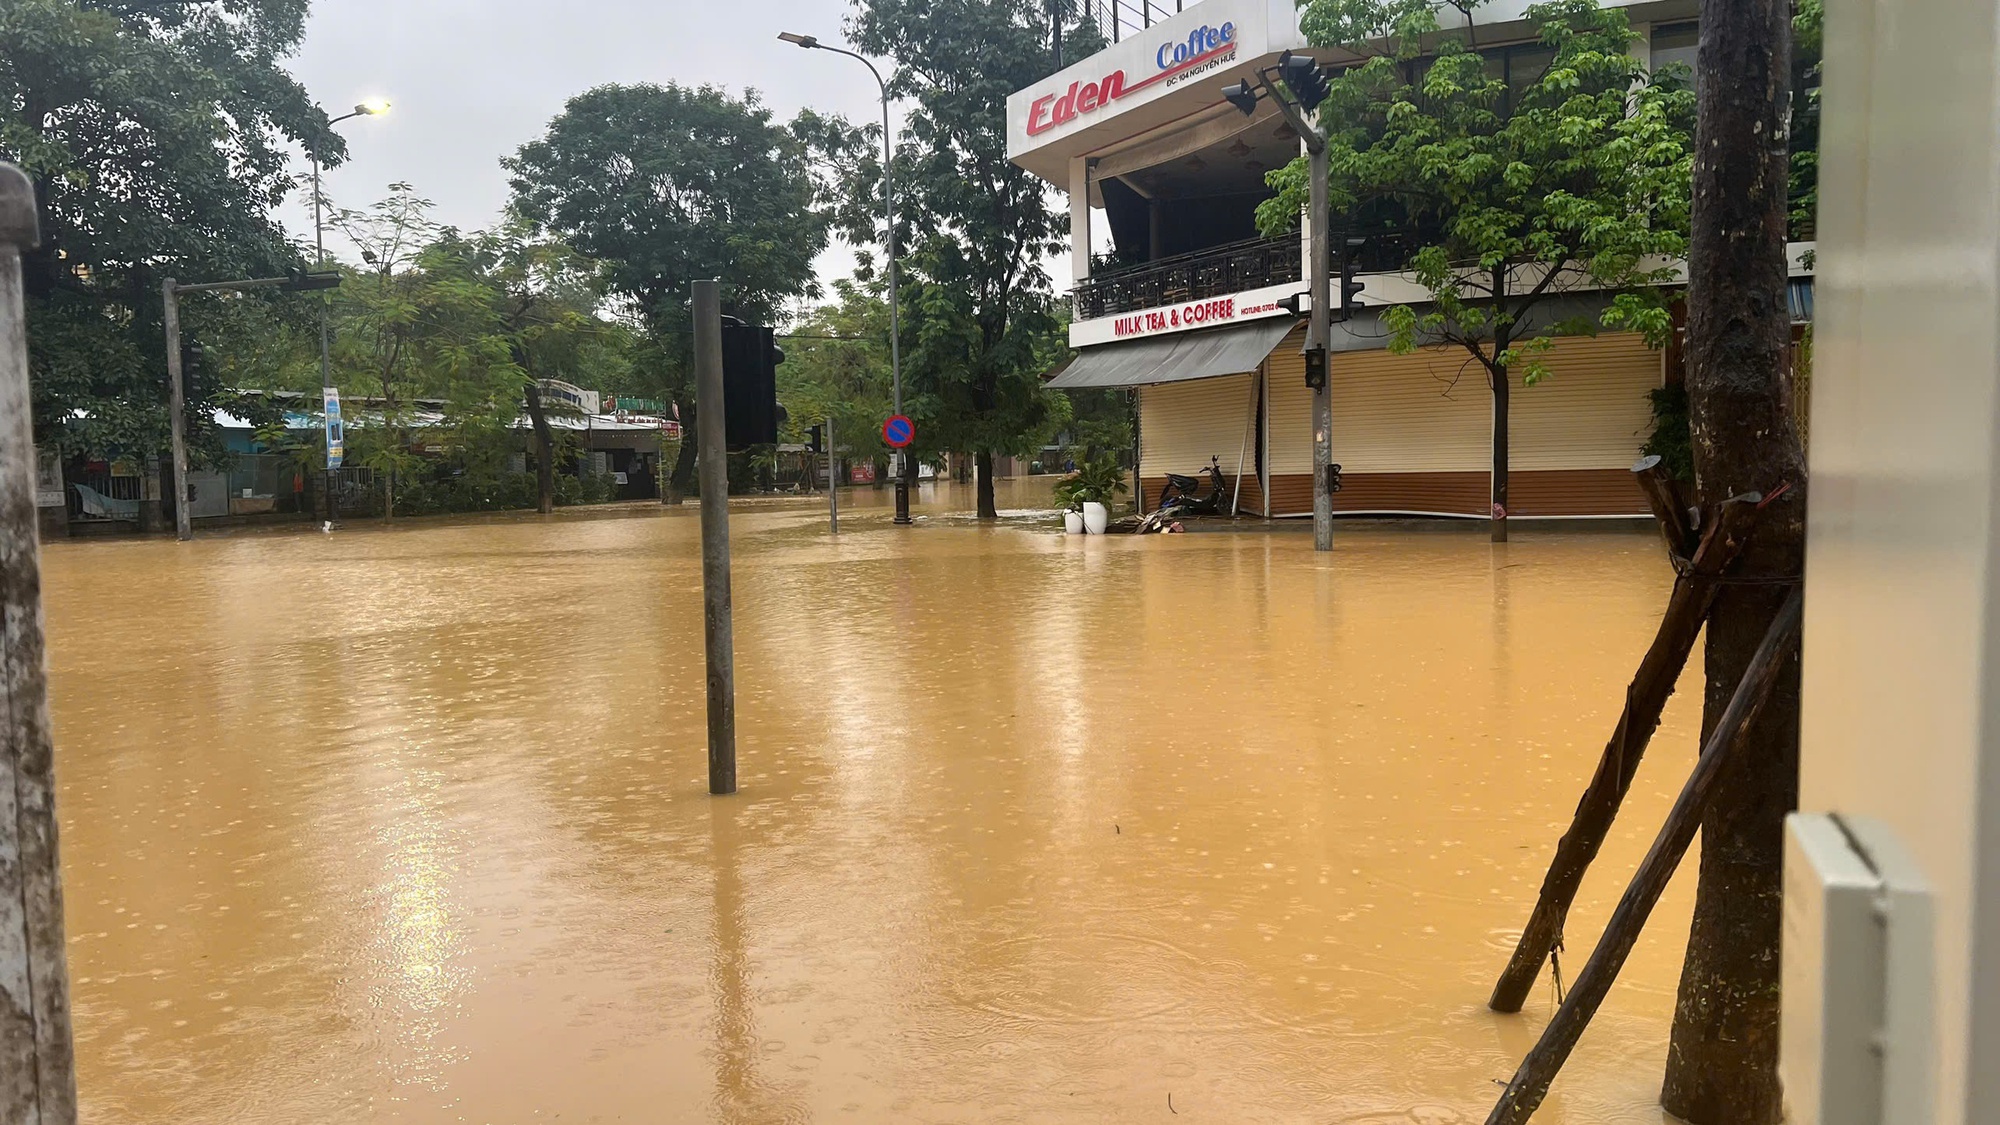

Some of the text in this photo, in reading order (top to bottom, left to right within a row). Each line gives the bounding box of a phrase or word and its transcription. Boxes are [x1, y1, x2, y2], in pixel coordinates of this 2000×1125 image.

[1156, 21, 1235, 70] Coffee
[1179, 72, 1189, 81] 104
[1026, 69, 1125, 136] Eden
[1114, 298, 1233, 336] MILK TEA & COFFEE
